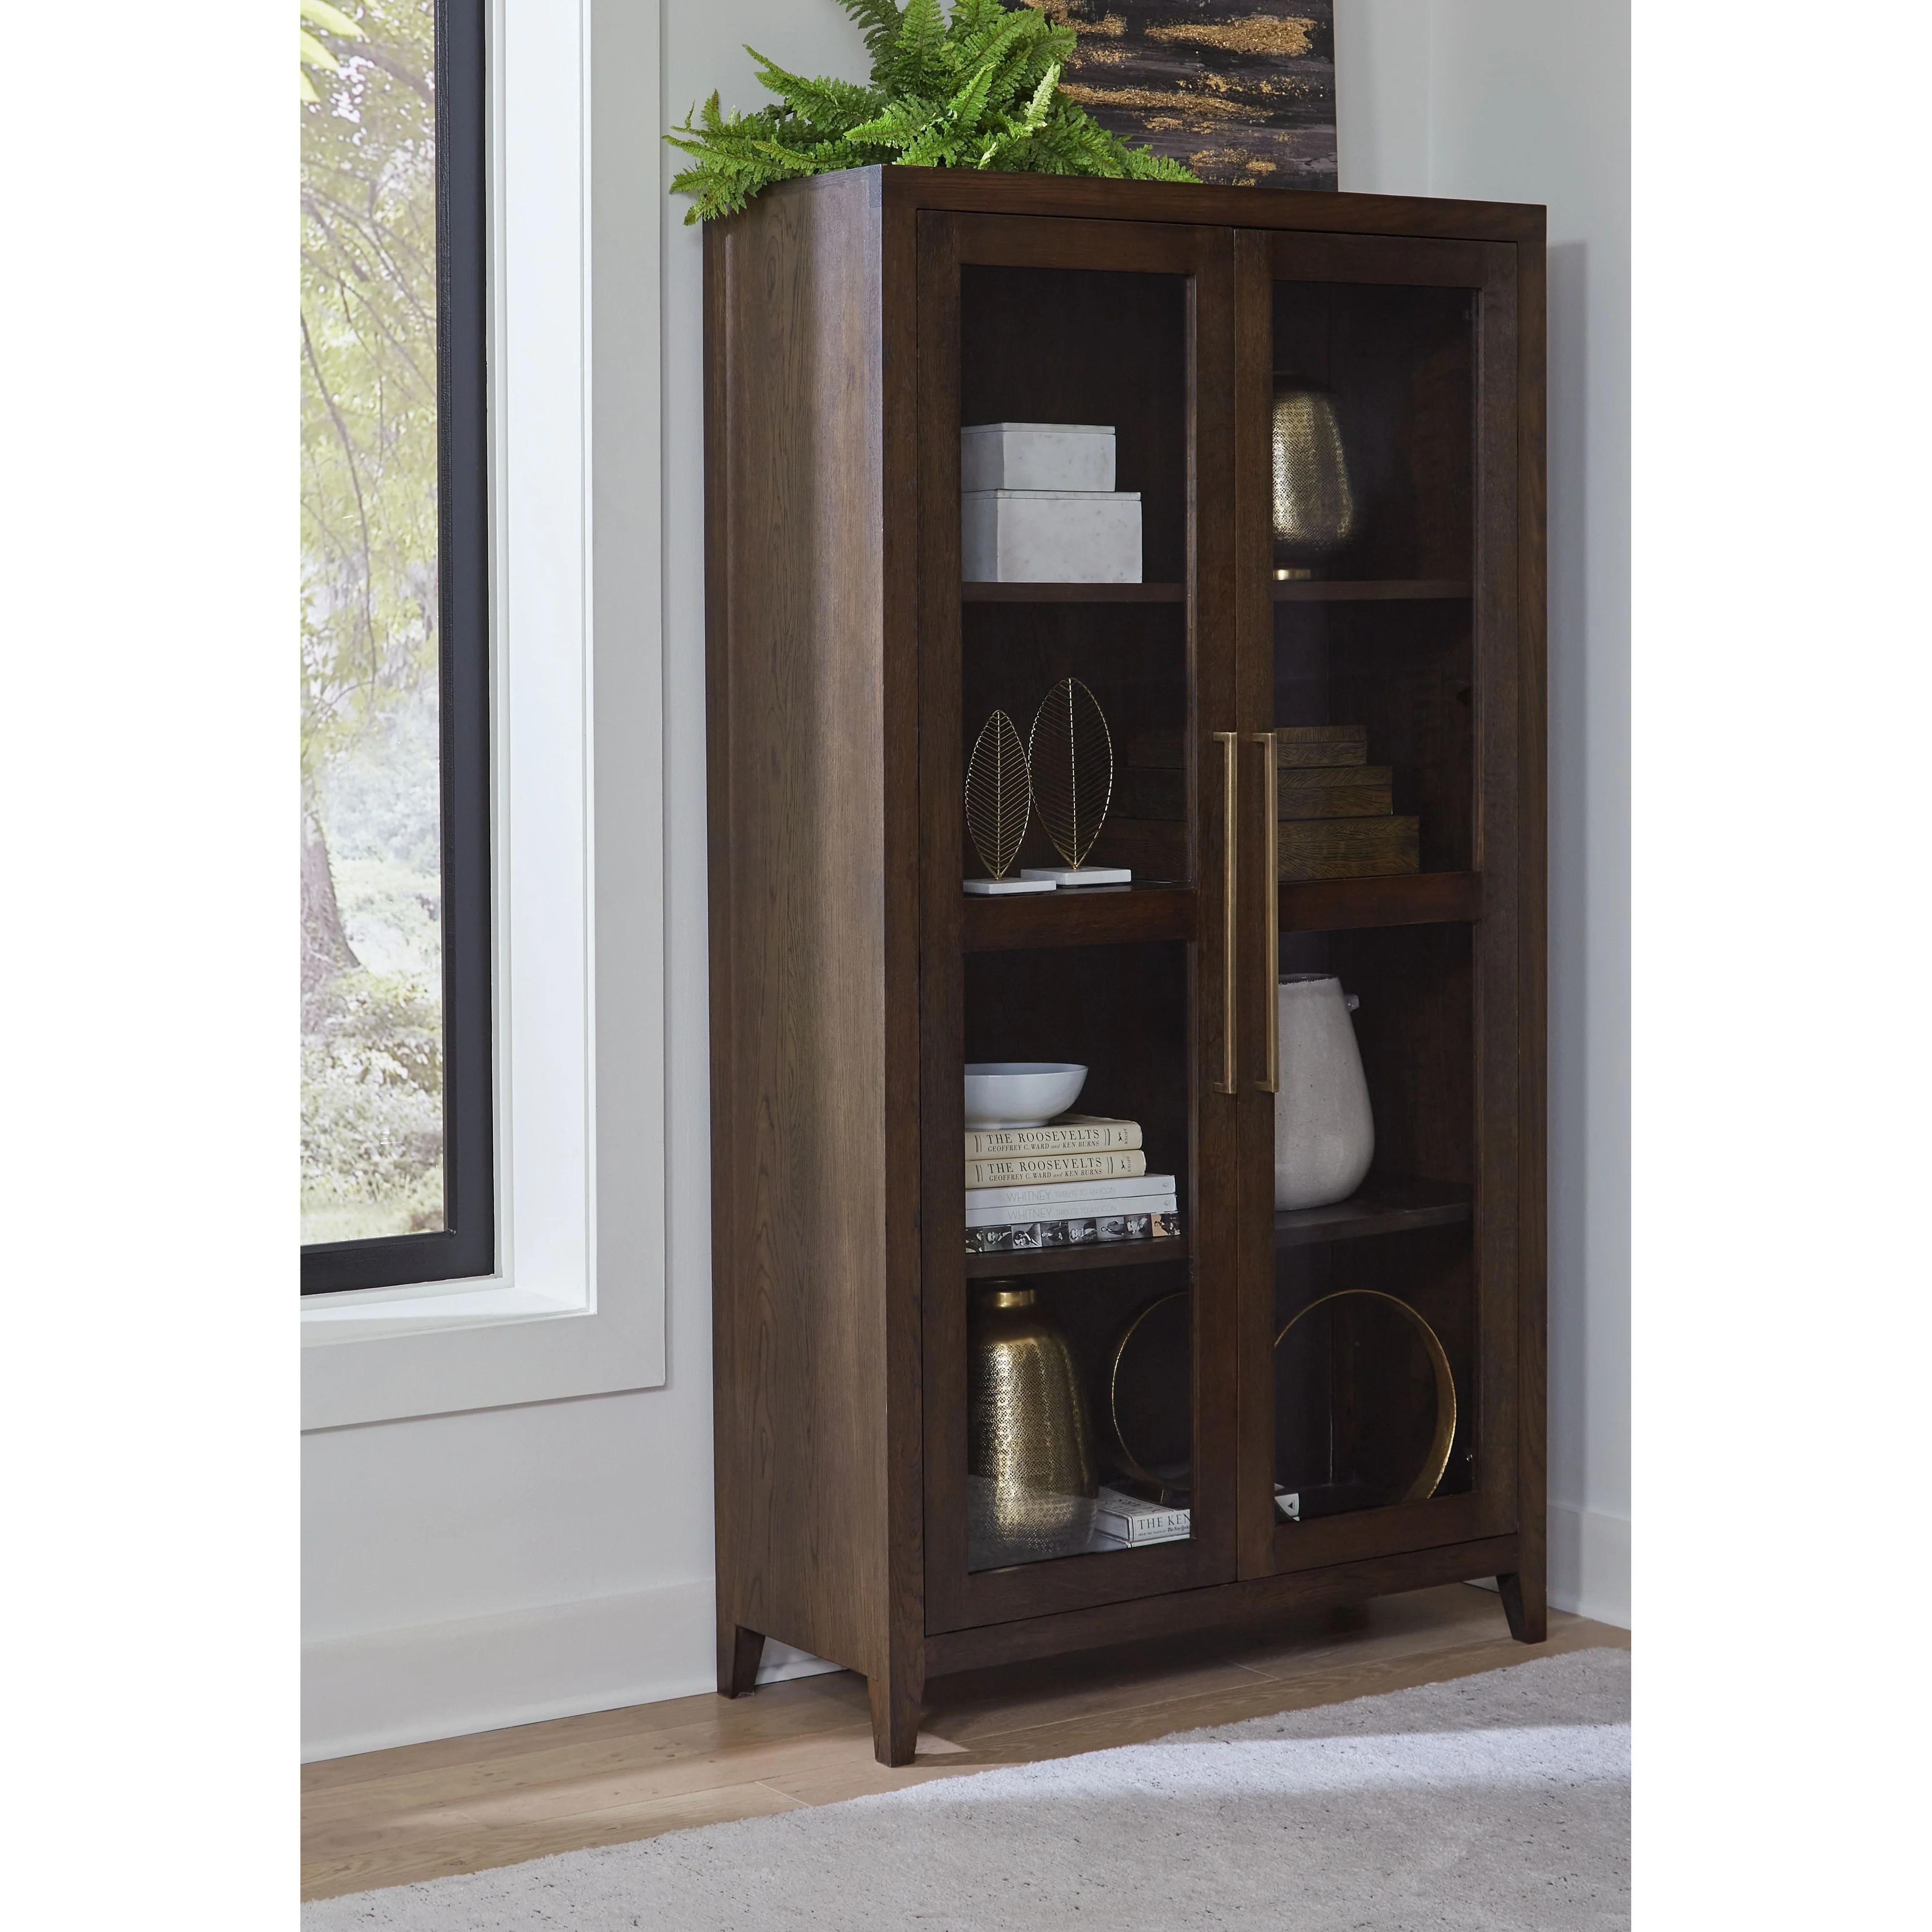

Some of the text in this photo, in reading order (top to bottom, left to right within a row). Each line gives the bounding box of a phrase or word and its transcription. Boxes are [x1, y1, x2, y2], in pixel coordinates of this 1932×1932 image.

[986, 1129, 1099, 1144] THE ROOSEVELTS
[988, 1157, 1102, 1173] THE ROOSEVELTS
[1007, 1189, 1051, 1202] WHITNEY
[1008, 1208, 1052, 1220] WHITNEY
[1056, 1208, 1079, 1216] TRIBUTE
[1137, 1517, 1163, 1530] THE
